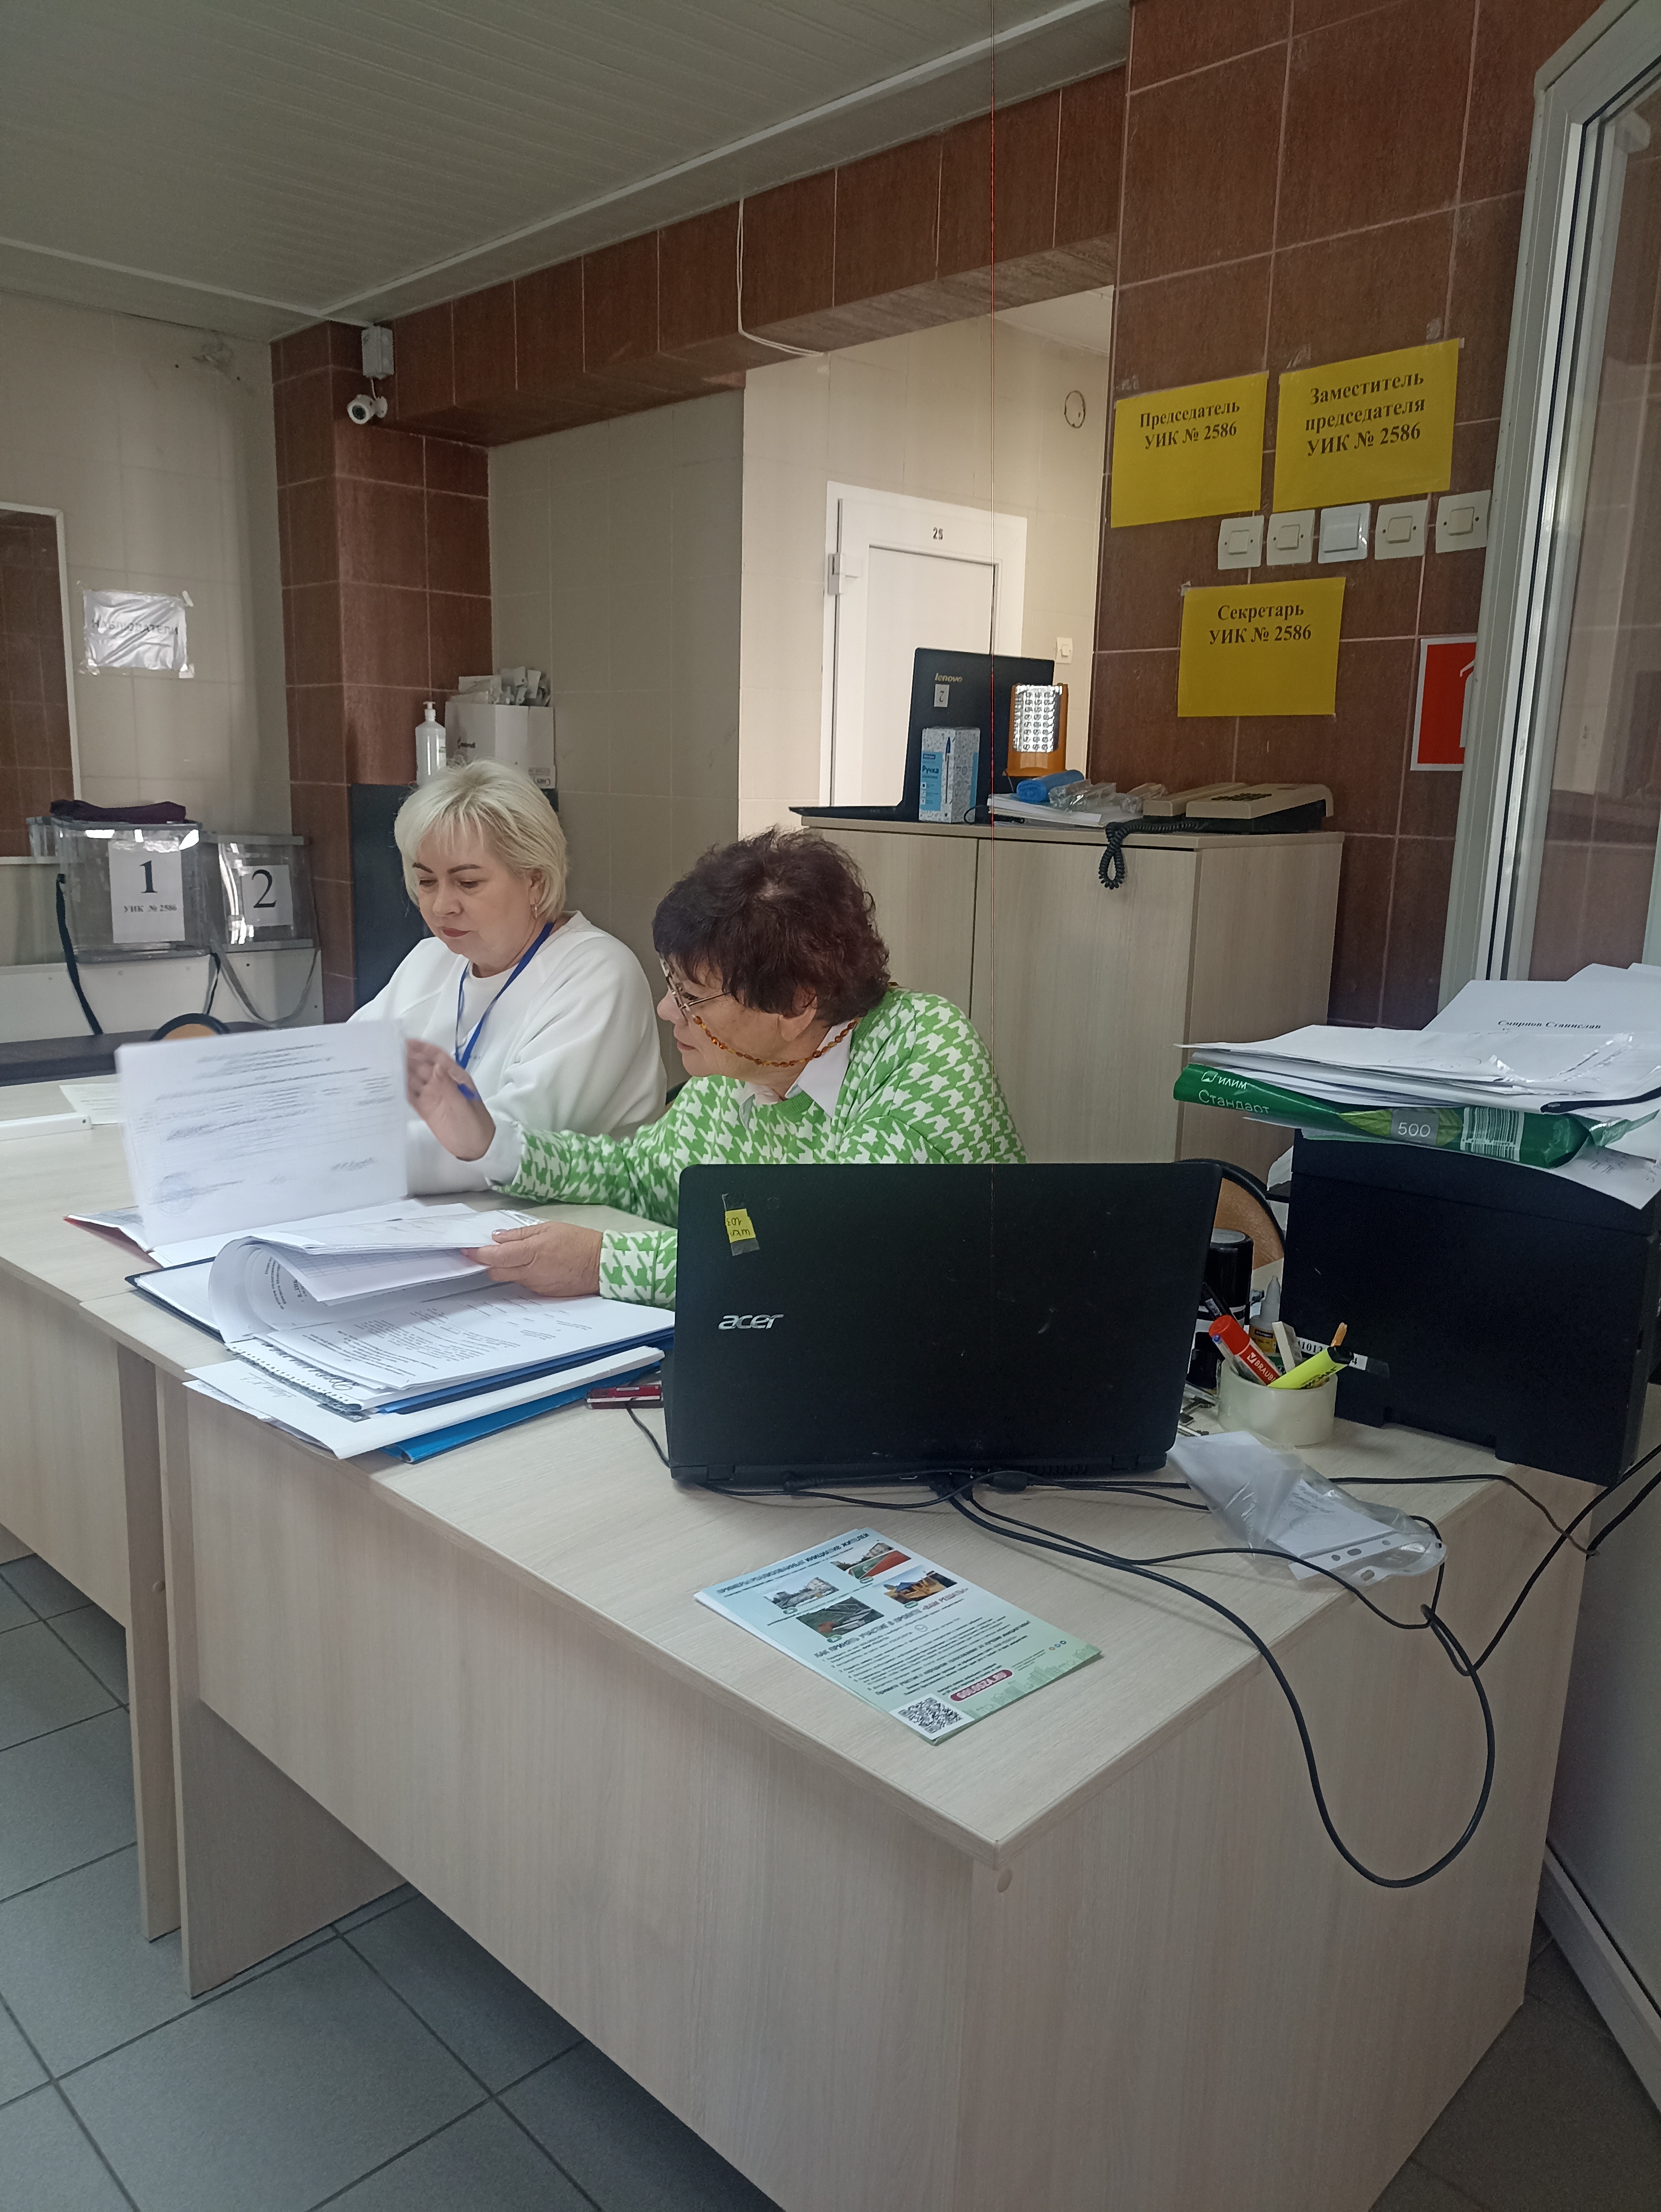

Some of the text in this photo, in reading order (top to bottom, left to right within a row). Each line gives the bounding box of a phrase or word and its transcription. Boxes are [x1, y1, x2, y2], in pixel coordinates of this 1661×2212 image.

[1310, 372, 1425, 405] Заместитель
[1140, 400, 1240, 428] Председатель
[1305, 398, 1425, 431] председателя
[1145, 422, 1237, 450] УИК № 2586
[1307, 422, 1421, 456] УИК № 2586
[933, 527, 943, 541] 25
[1218, 603, 1304, 623] Секретарь
[1209, 624, 1312, 645] УИК № 2586
[934, 672, 963, 683] lenovo
[140, 861, 158, 893] 1
[252, 869, 277, 908] 2
[1398, 1122, 1431, 1137] 500
[718, 1314, 784, 1329] acer
